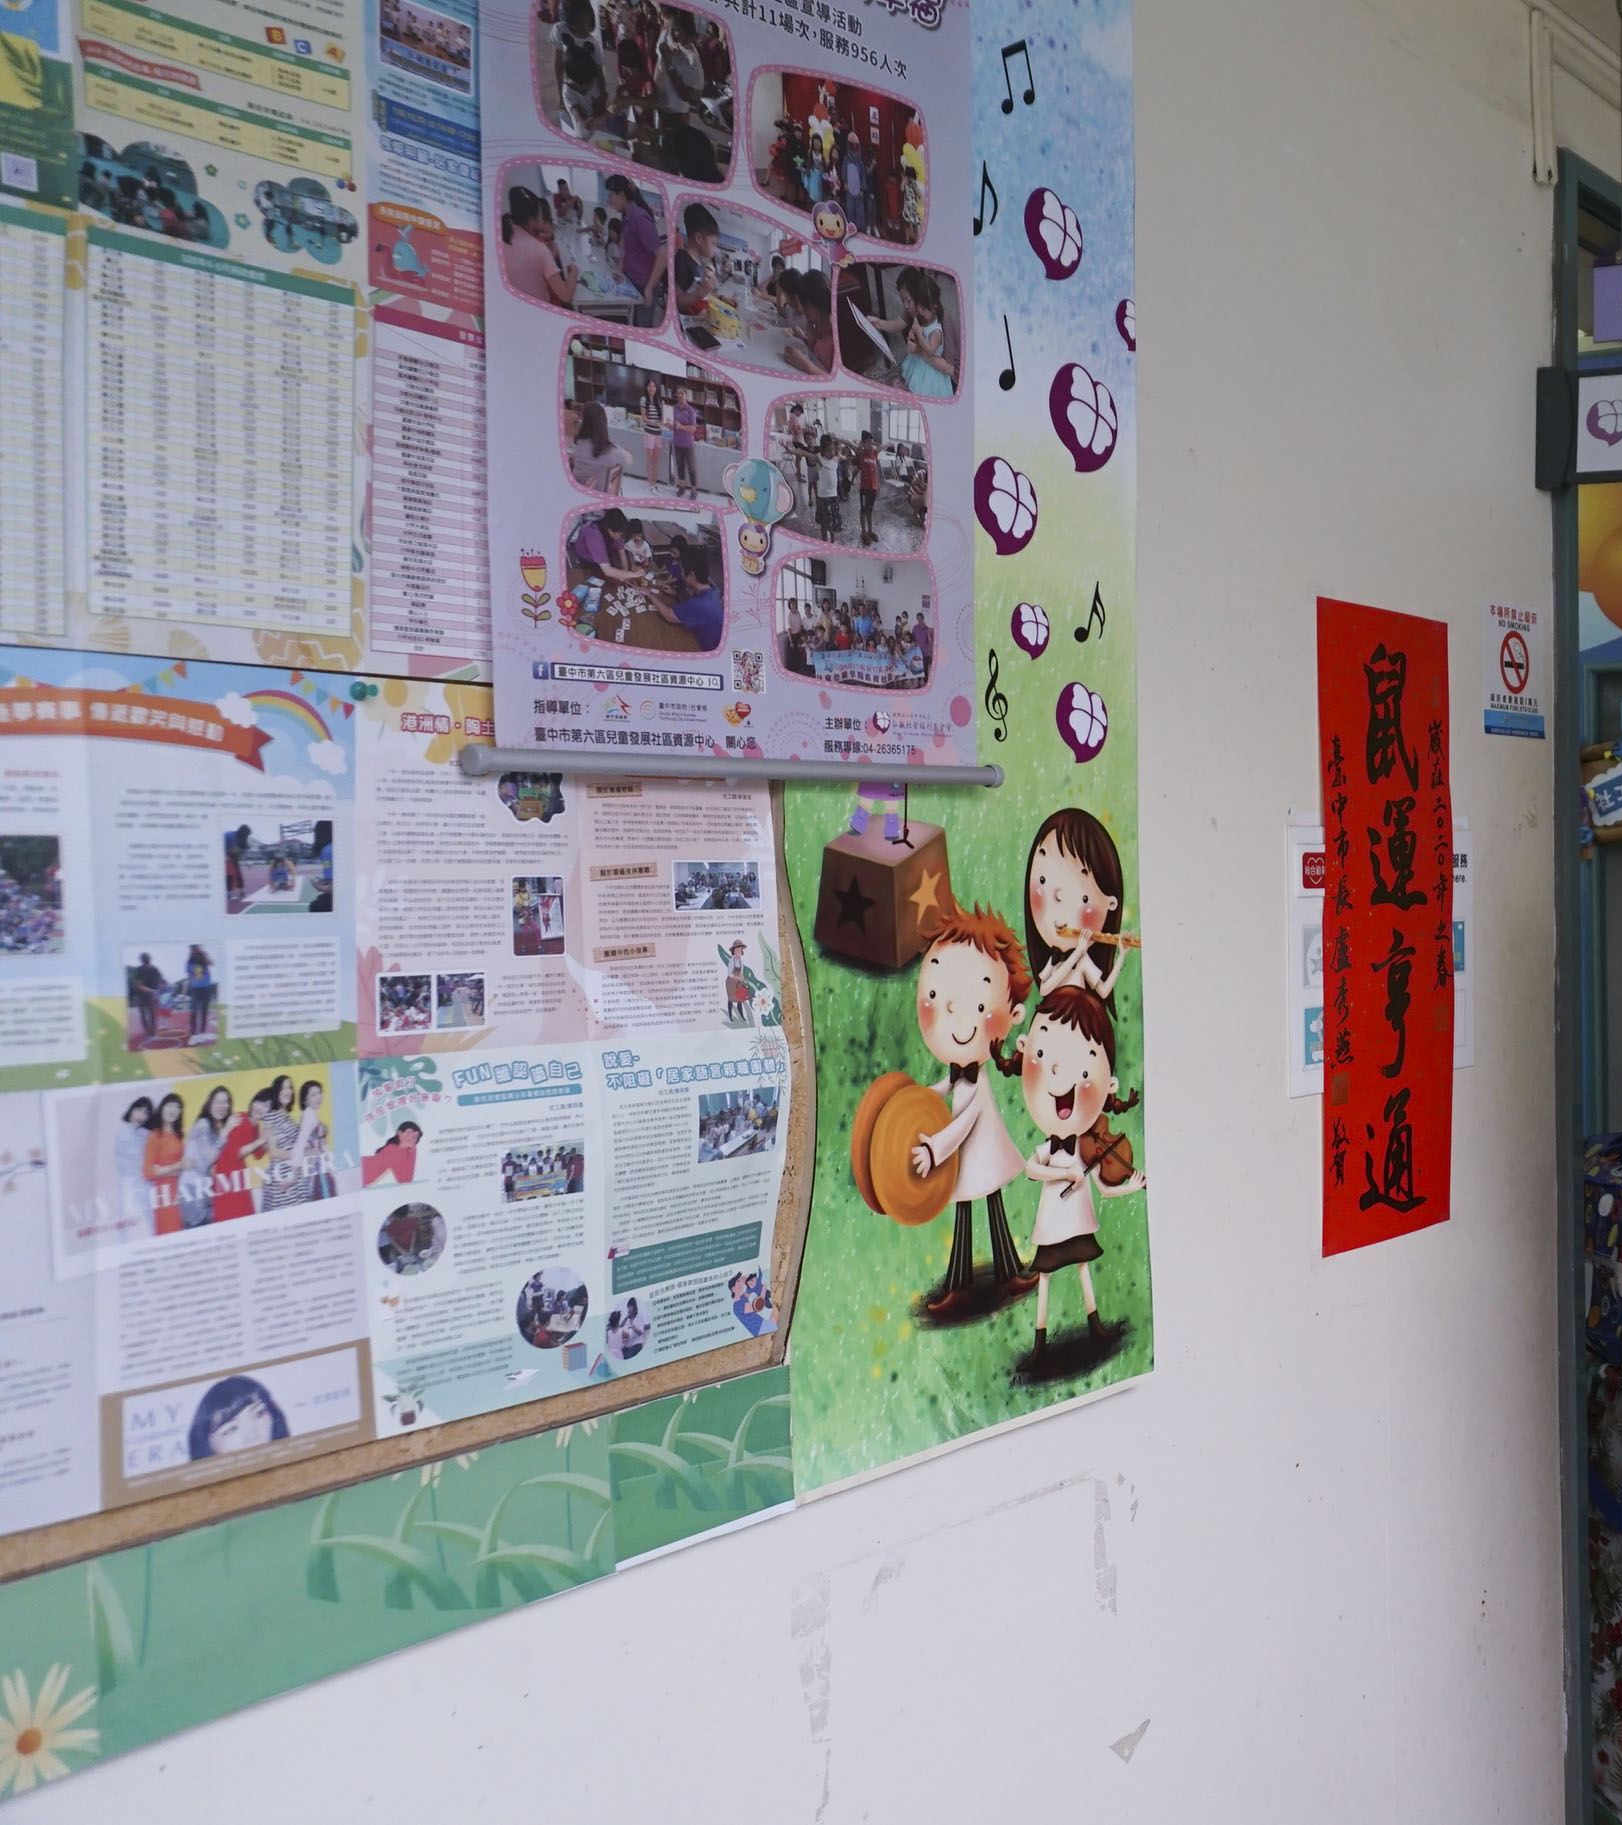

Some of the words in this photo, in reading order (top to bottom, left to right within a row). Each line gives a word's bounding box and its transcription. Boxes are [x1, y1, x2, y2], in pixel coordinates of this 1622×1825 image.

[1507, 620, 1531, 632] SMOKING
[558, 666, 704, 687] 臺中市第六區兒童發展社區資源中心
[534, 727, 716, 748] 臺中市第六區兒童發展社區資源中心
[725, 735, 756, 750] 關心您
